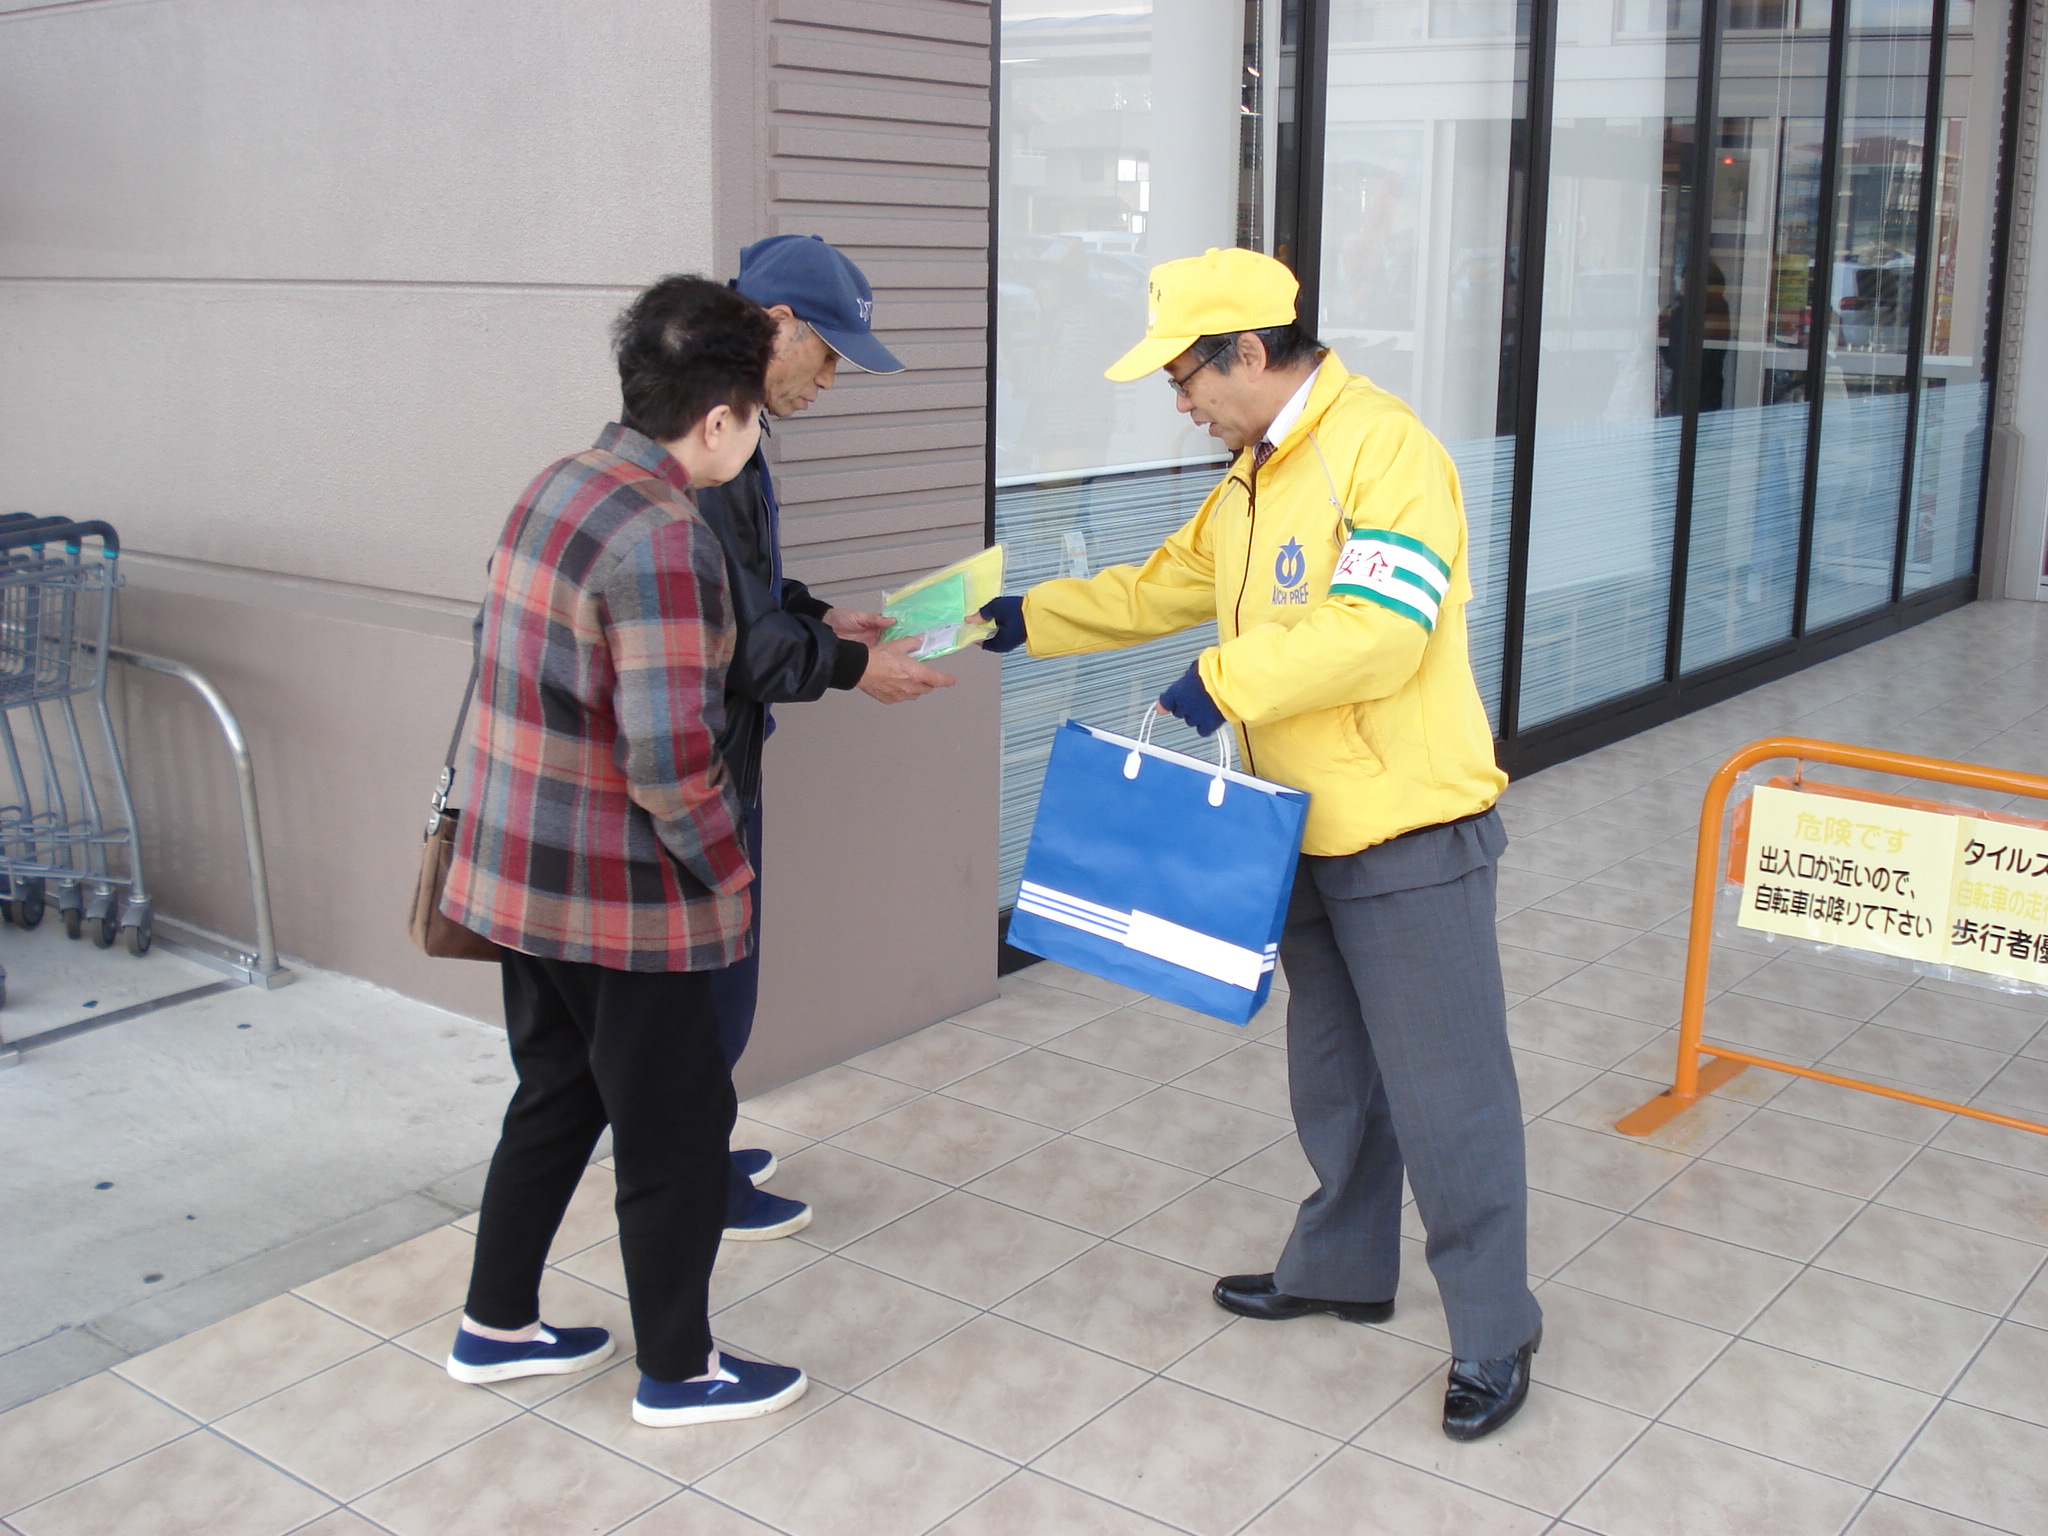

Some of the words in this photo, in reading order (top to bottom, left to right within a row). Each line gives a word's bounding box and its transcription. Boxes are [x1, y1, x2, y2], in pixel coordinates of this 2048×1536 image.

[1335, 549, 1388, 582] 安全
[1289, 582, 1309, 605] PREF
[1794, 812, 1911, 854] 危険です
[1759, 845, 1915, 900] 出入口が近いので、
[1754, 884, 1932, 938] 自転車は降りて下さい
[1957, 880, 2048, 922] 自転車の走
